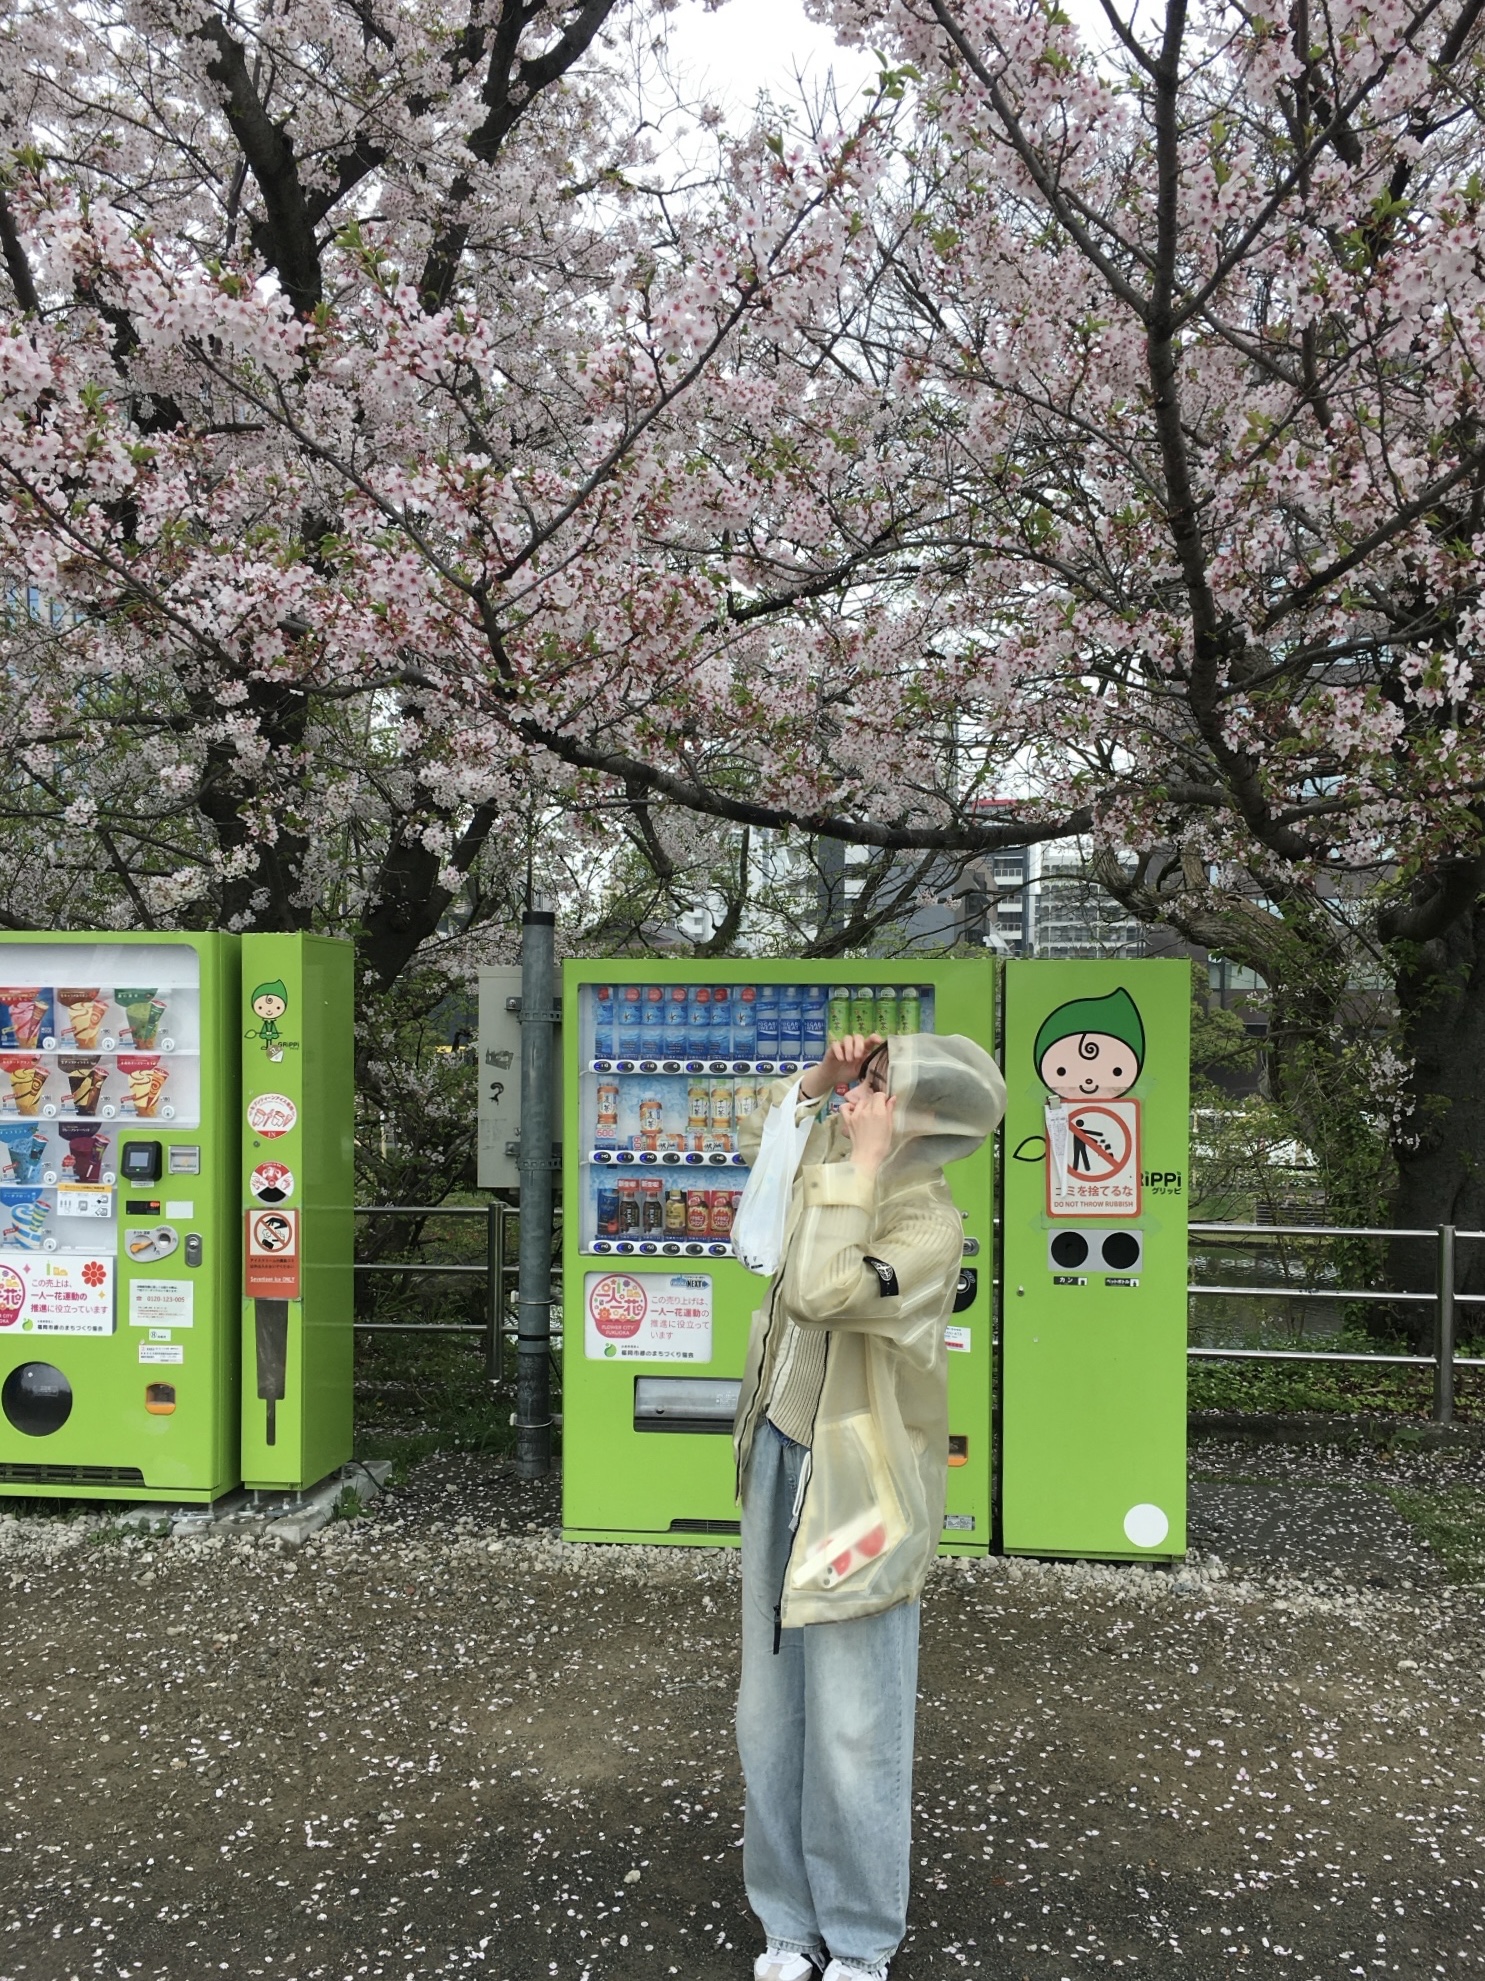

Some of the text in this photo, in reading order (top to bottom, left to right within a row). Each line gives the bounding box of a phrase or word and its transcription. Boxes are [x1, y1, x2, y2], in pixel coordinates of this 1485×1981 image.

[1141, 1171, 1182, 1188] iPPi
[1152, 1187, 1182, 1195] グリッピ
[31, 1279, 73, 1288] この売上は、
[687, 1280, 702, 1288] NEXT
[30, 1291, 88, 1301] 一人一花運動の
[651, 1296, 709, 1306] この売り上げは、
[30, 1304, 109, 1314] 推進に役立っています
[650, 1307, 710, 1318] 一人一花運動の
[650, 1319, 710, 1330] 推進に役立って
[650, 1331, 674, 1340] います
